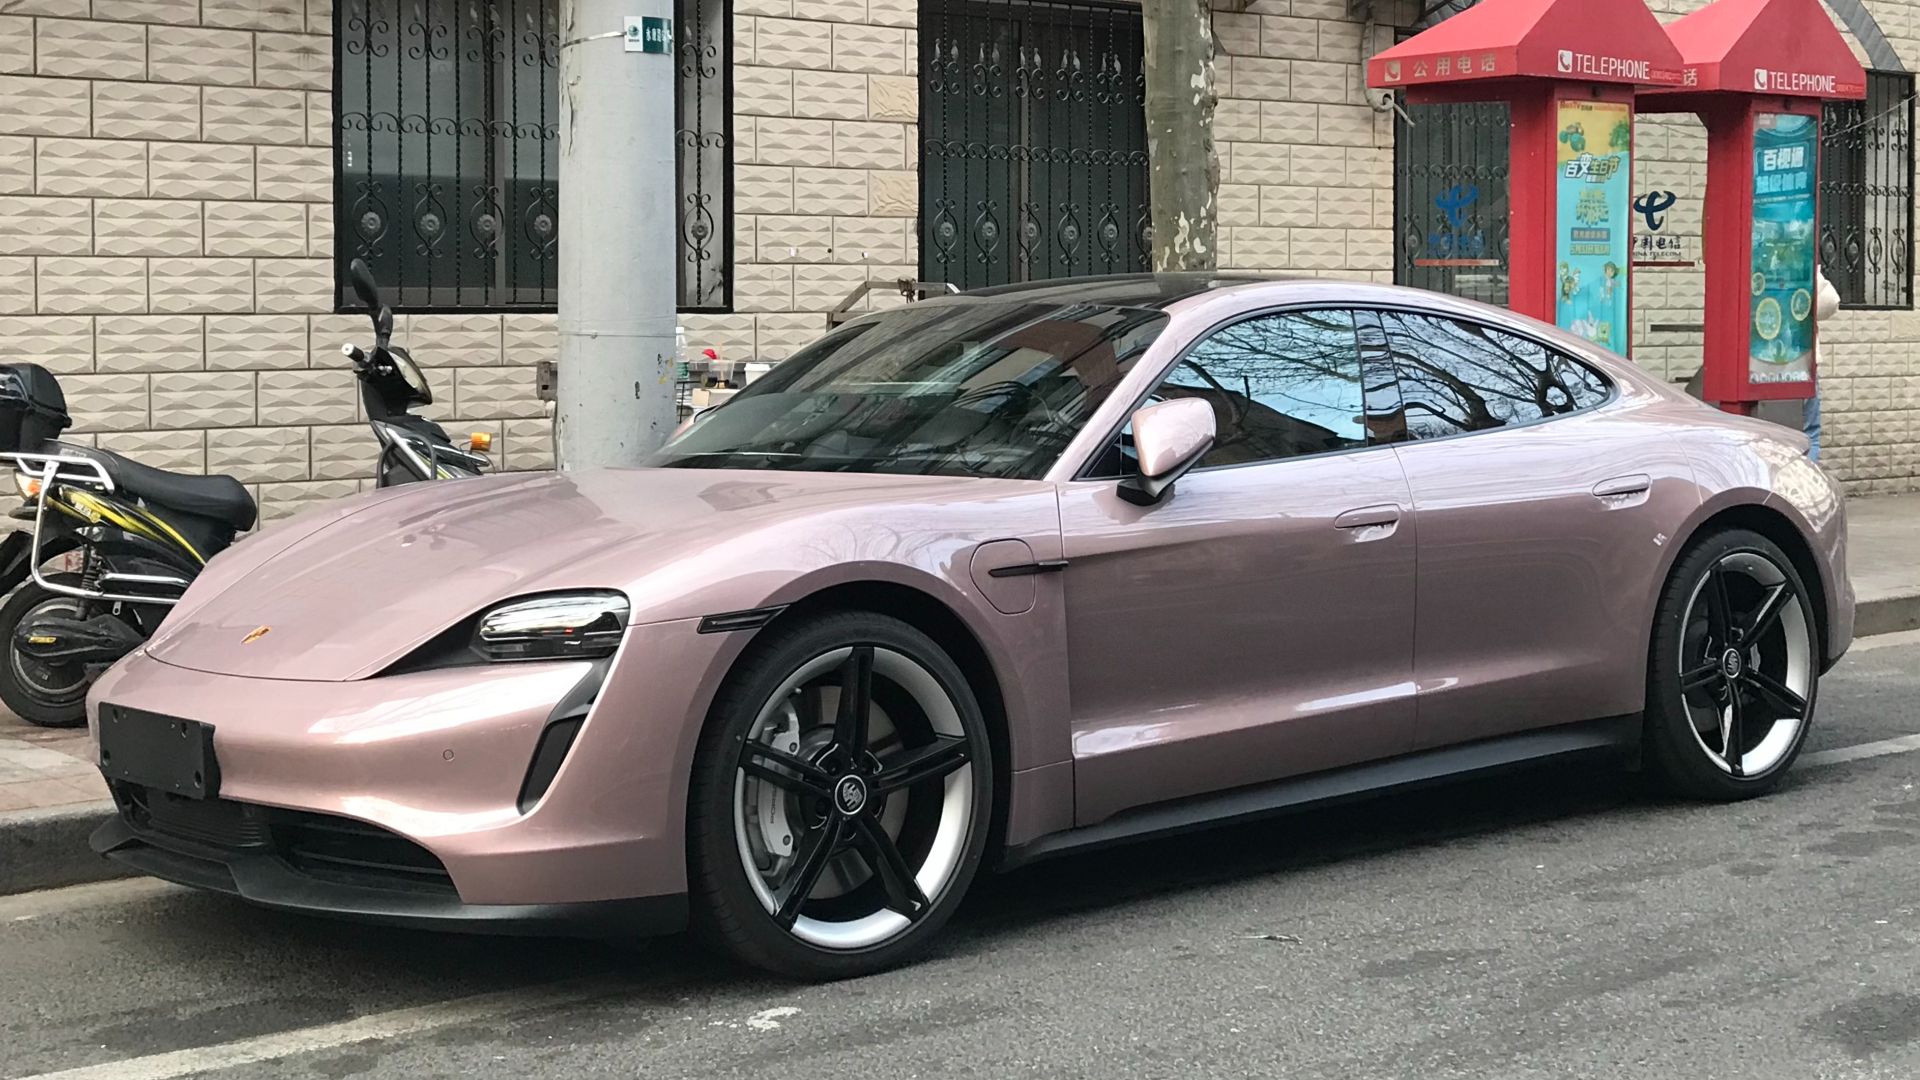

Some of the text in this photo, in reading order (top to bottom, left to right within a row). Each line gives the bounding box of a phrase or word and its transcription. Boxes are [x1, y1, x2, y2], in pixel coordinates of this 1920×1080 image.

[1413, 52, 1496, 77] 公用电话
[1575, 53, 1650, 80] TELEPHONE
[1683, 68, 1697, 86] 话
[1770, 71, 1836, 93] TELEPHONE
